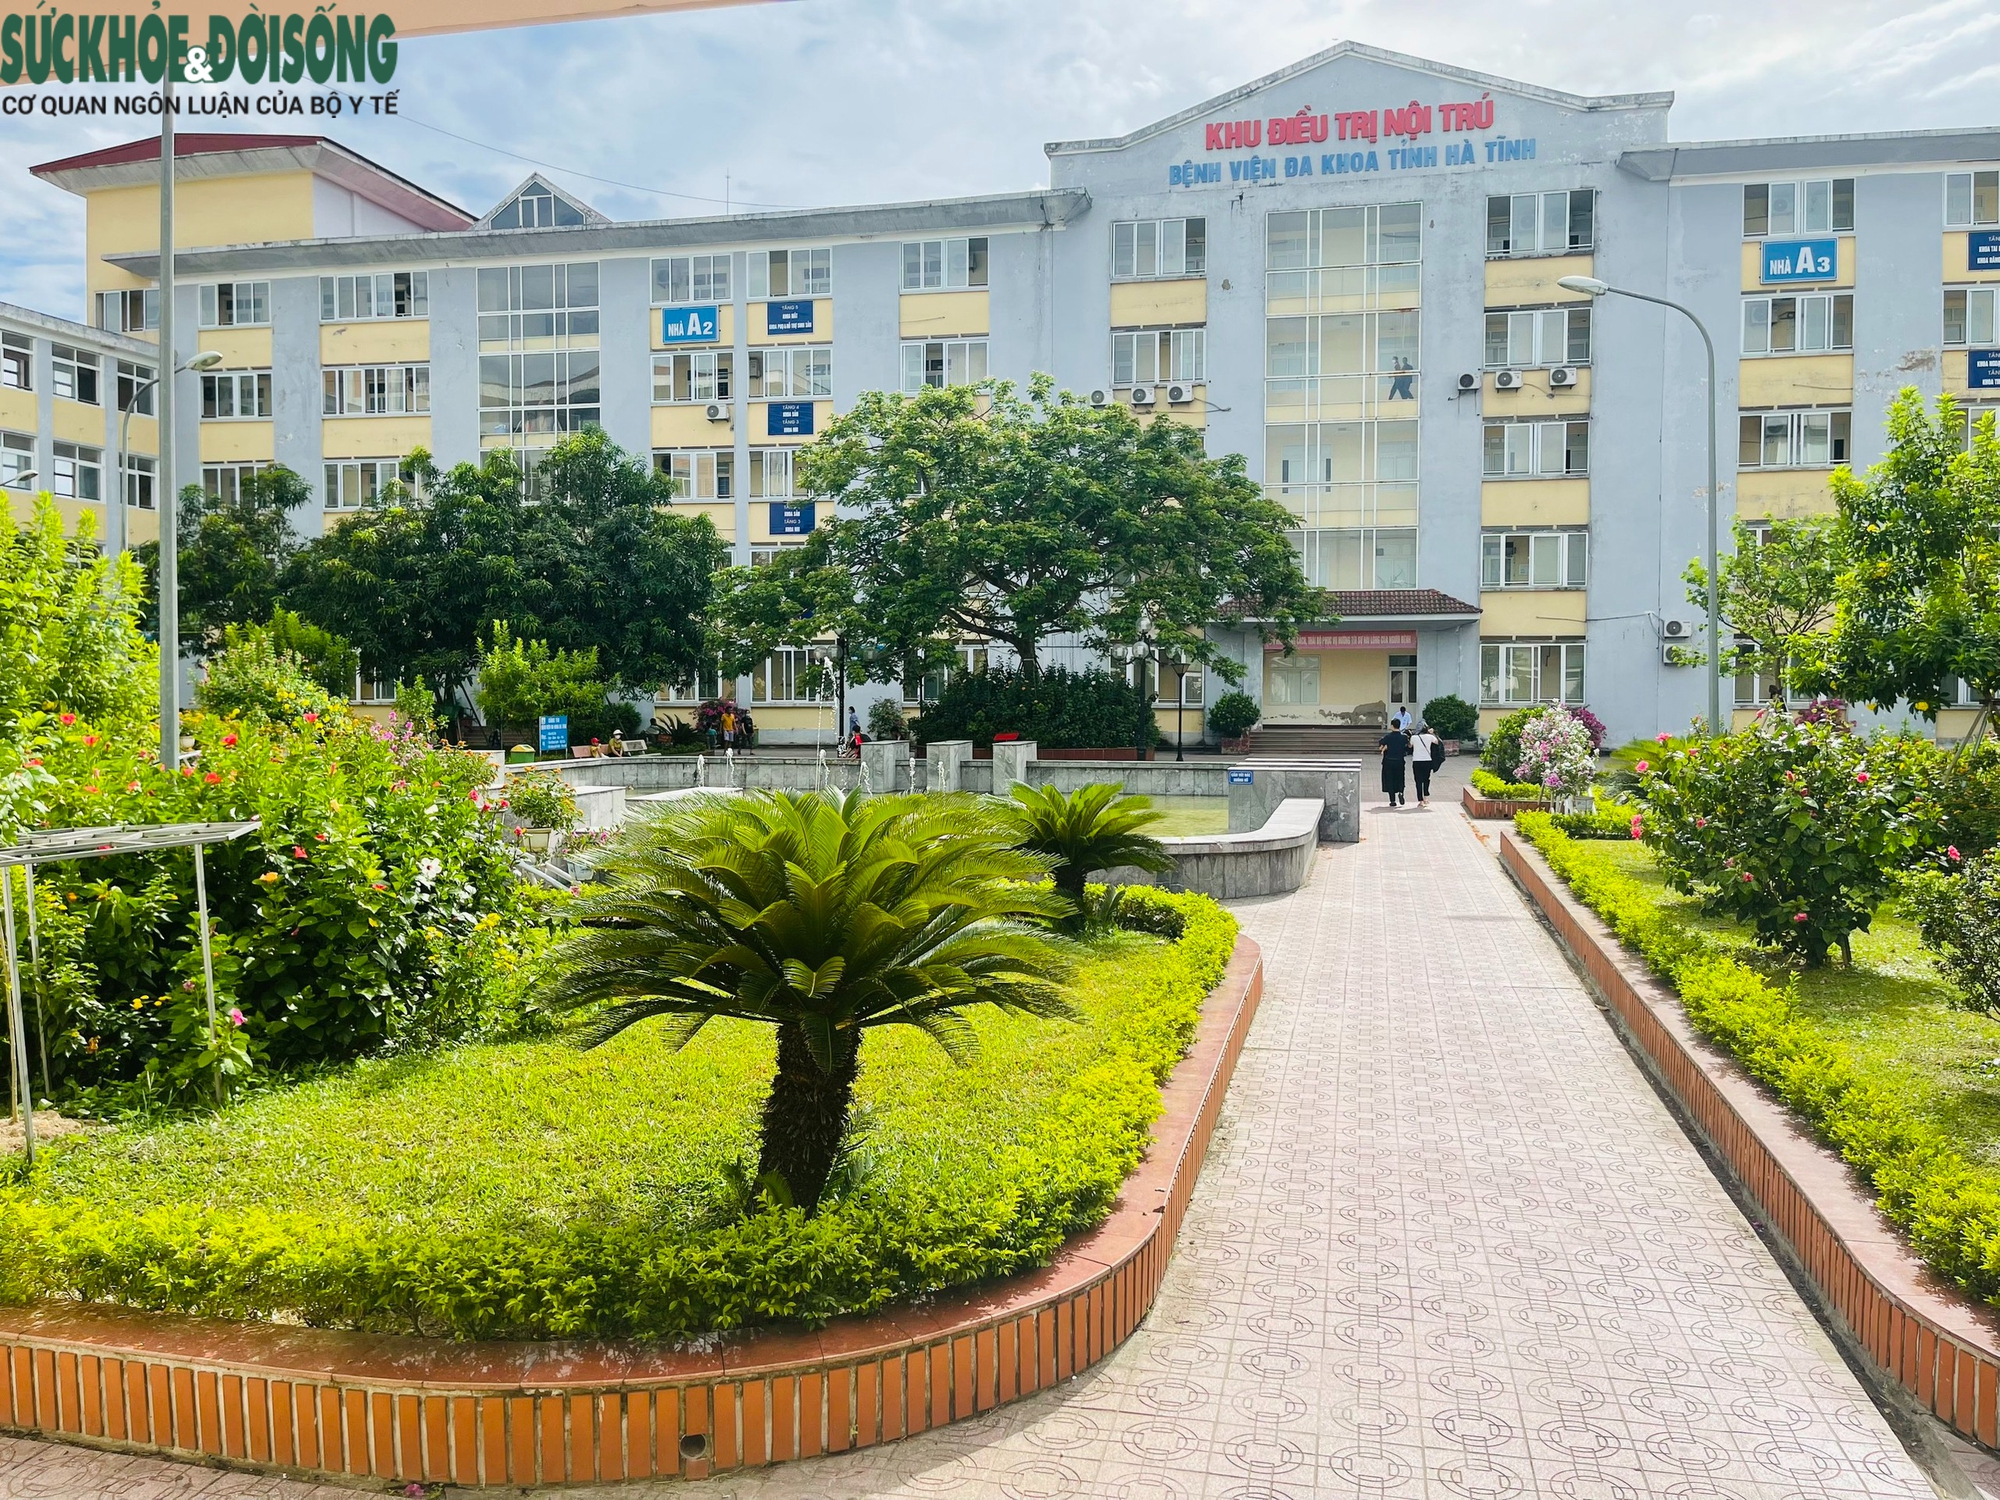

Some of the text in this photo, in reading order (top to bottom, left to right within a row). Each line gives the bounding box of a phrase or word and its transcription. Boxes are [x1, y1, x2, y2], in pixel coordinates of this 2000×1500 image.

[1205, 92, 1494, 150] KHU ĐIỀU TRỊ NỘI TRÚ
[1169, 135, 1536, 188] BỆNH VIỆN ĐA KHOA TỈNH HÀ TĨNH
[1770, 246, 1830, 275] NHÀ A3
[668, 312, 713, 336] NHÀ A2
